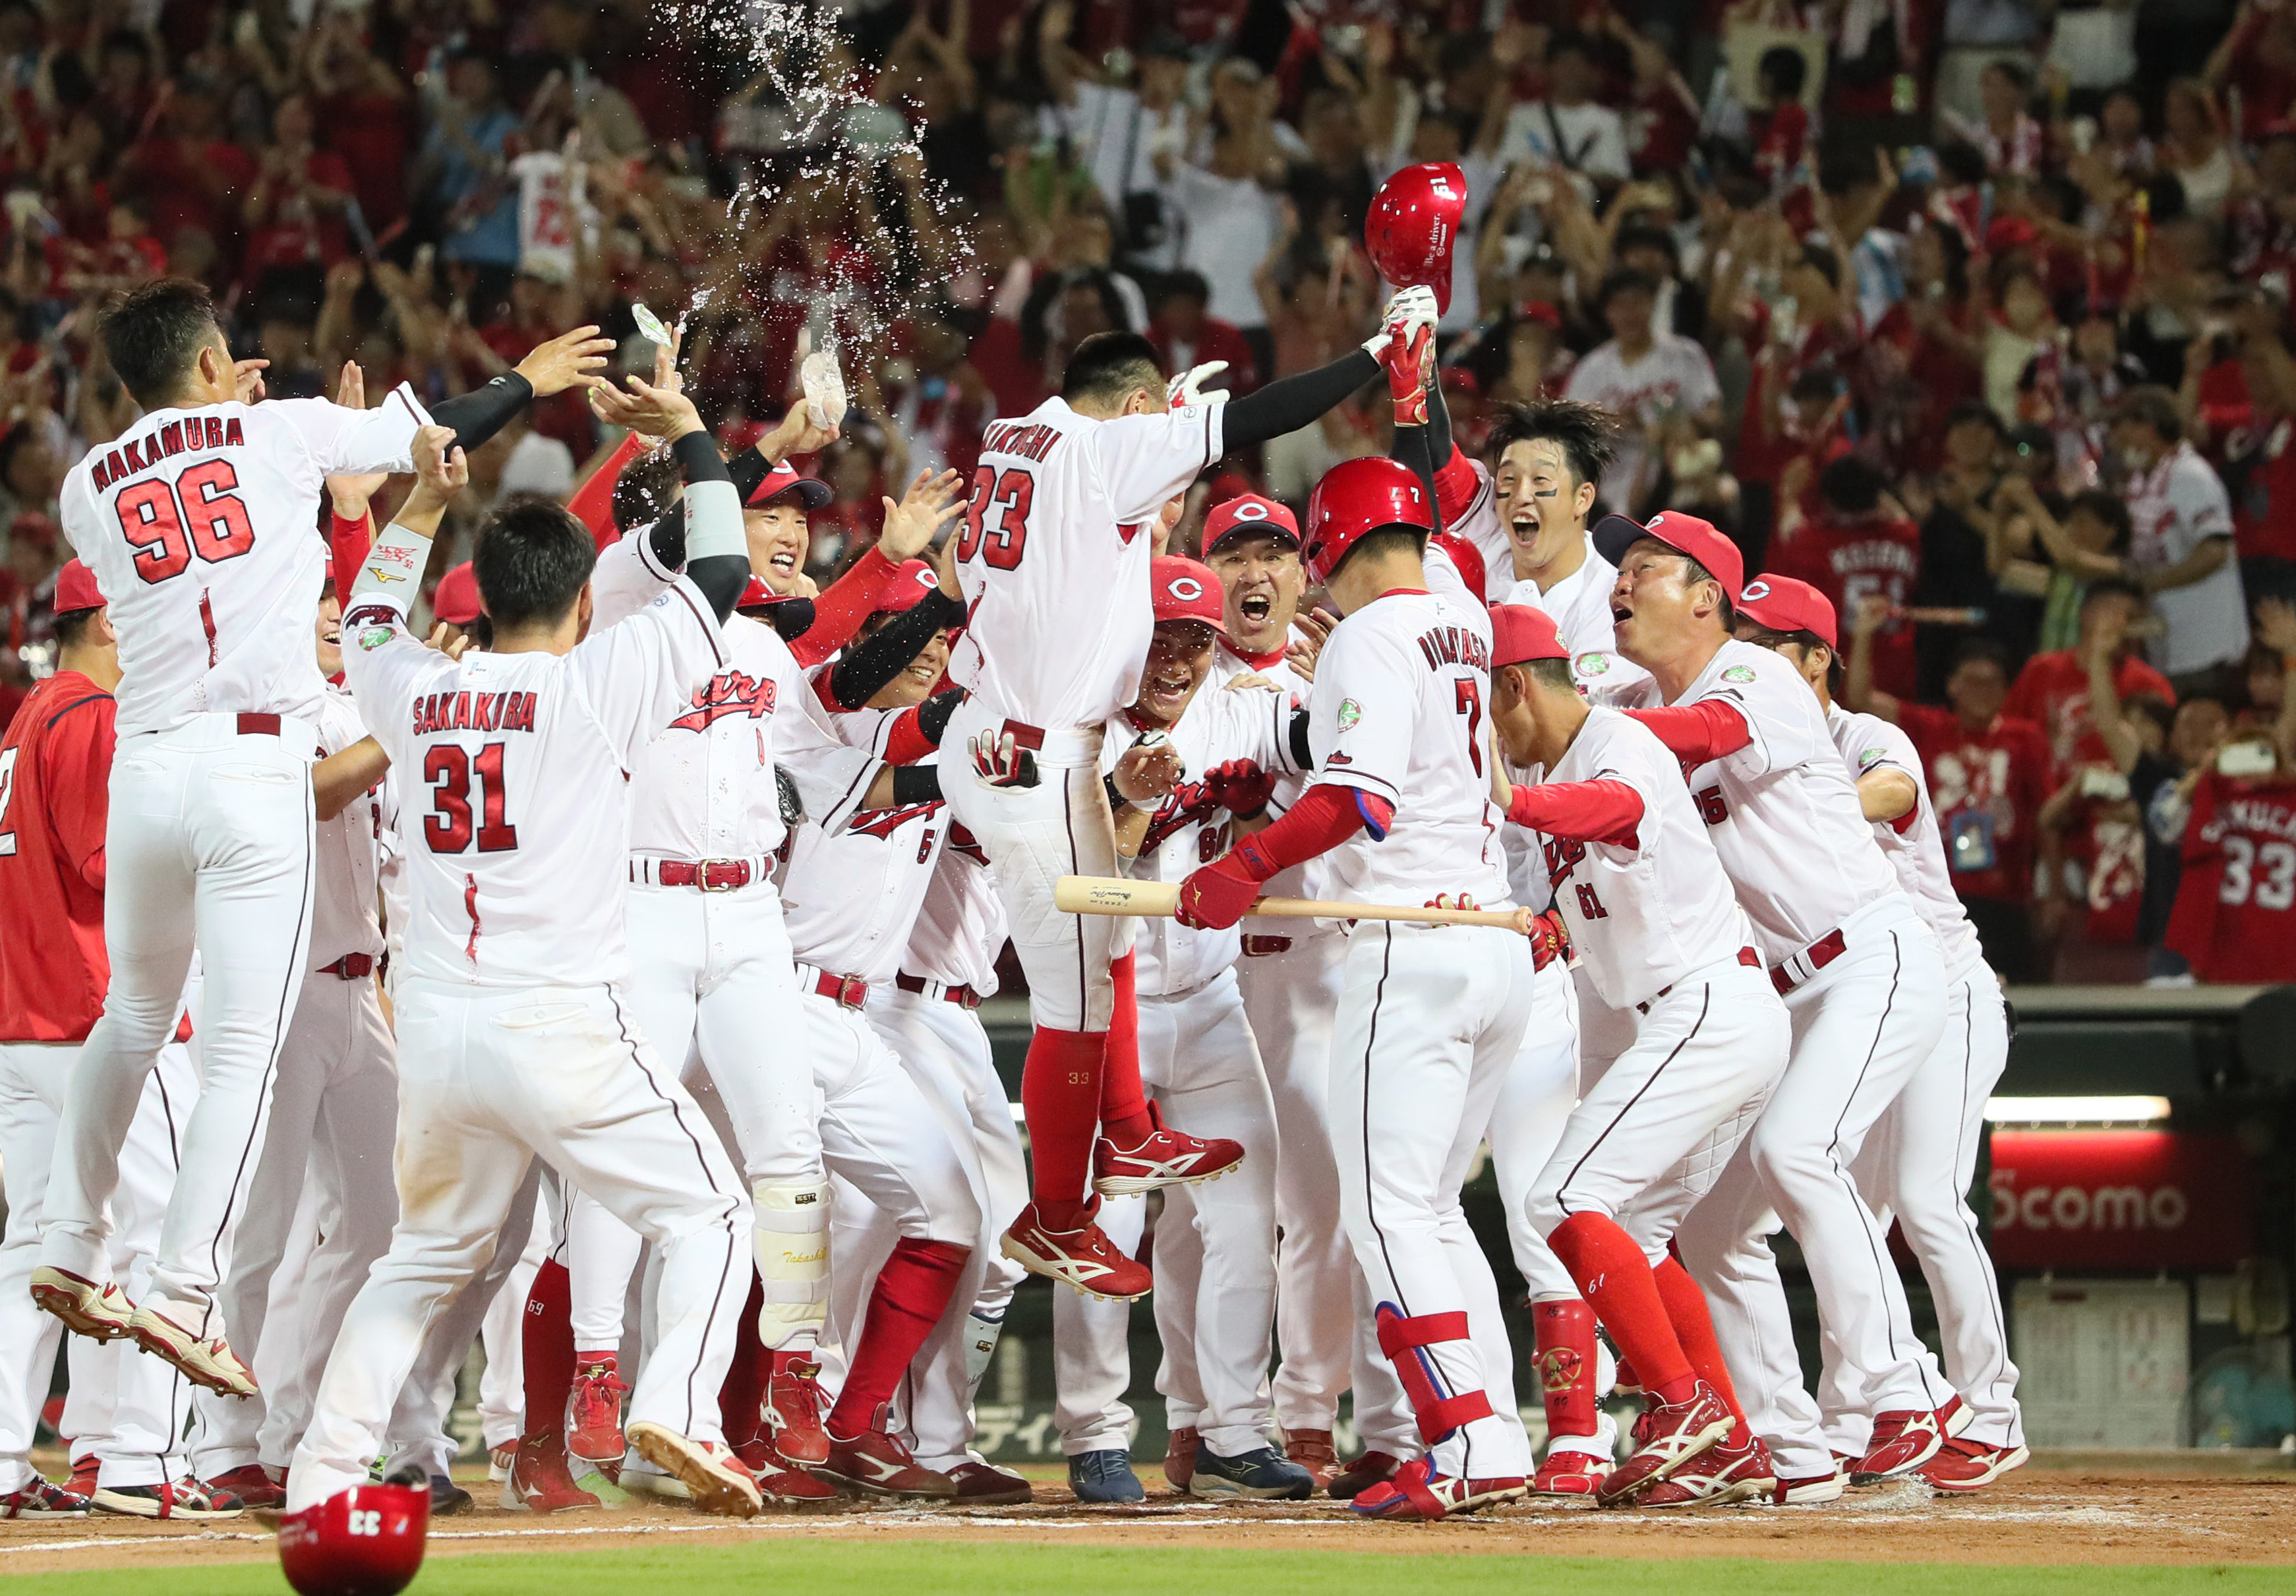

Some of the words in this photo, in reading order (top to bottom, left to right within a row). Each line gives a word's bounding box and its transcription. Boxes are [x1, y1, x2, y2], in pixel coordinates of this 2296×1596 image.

[91, 416, 245, 494] NAKAMURA
[115, 458, 256, 585] 96
[956, 464, 1035, 572] 33
[1409, 486, 1420, 504] 7
[1454, 677, 1483, 779] 7
[424, 742, 518, 855] 31
[2219, 835, 2296, 911] 33
[1069, 1072, 1089, 1084] 33
[1993, 1186, 2188, 1230] ocomo
[527, 1299, 545, 1316] 69
[1588, 1272, 1605, 1294] 61
[348, 1510, 381, 1537] 33
